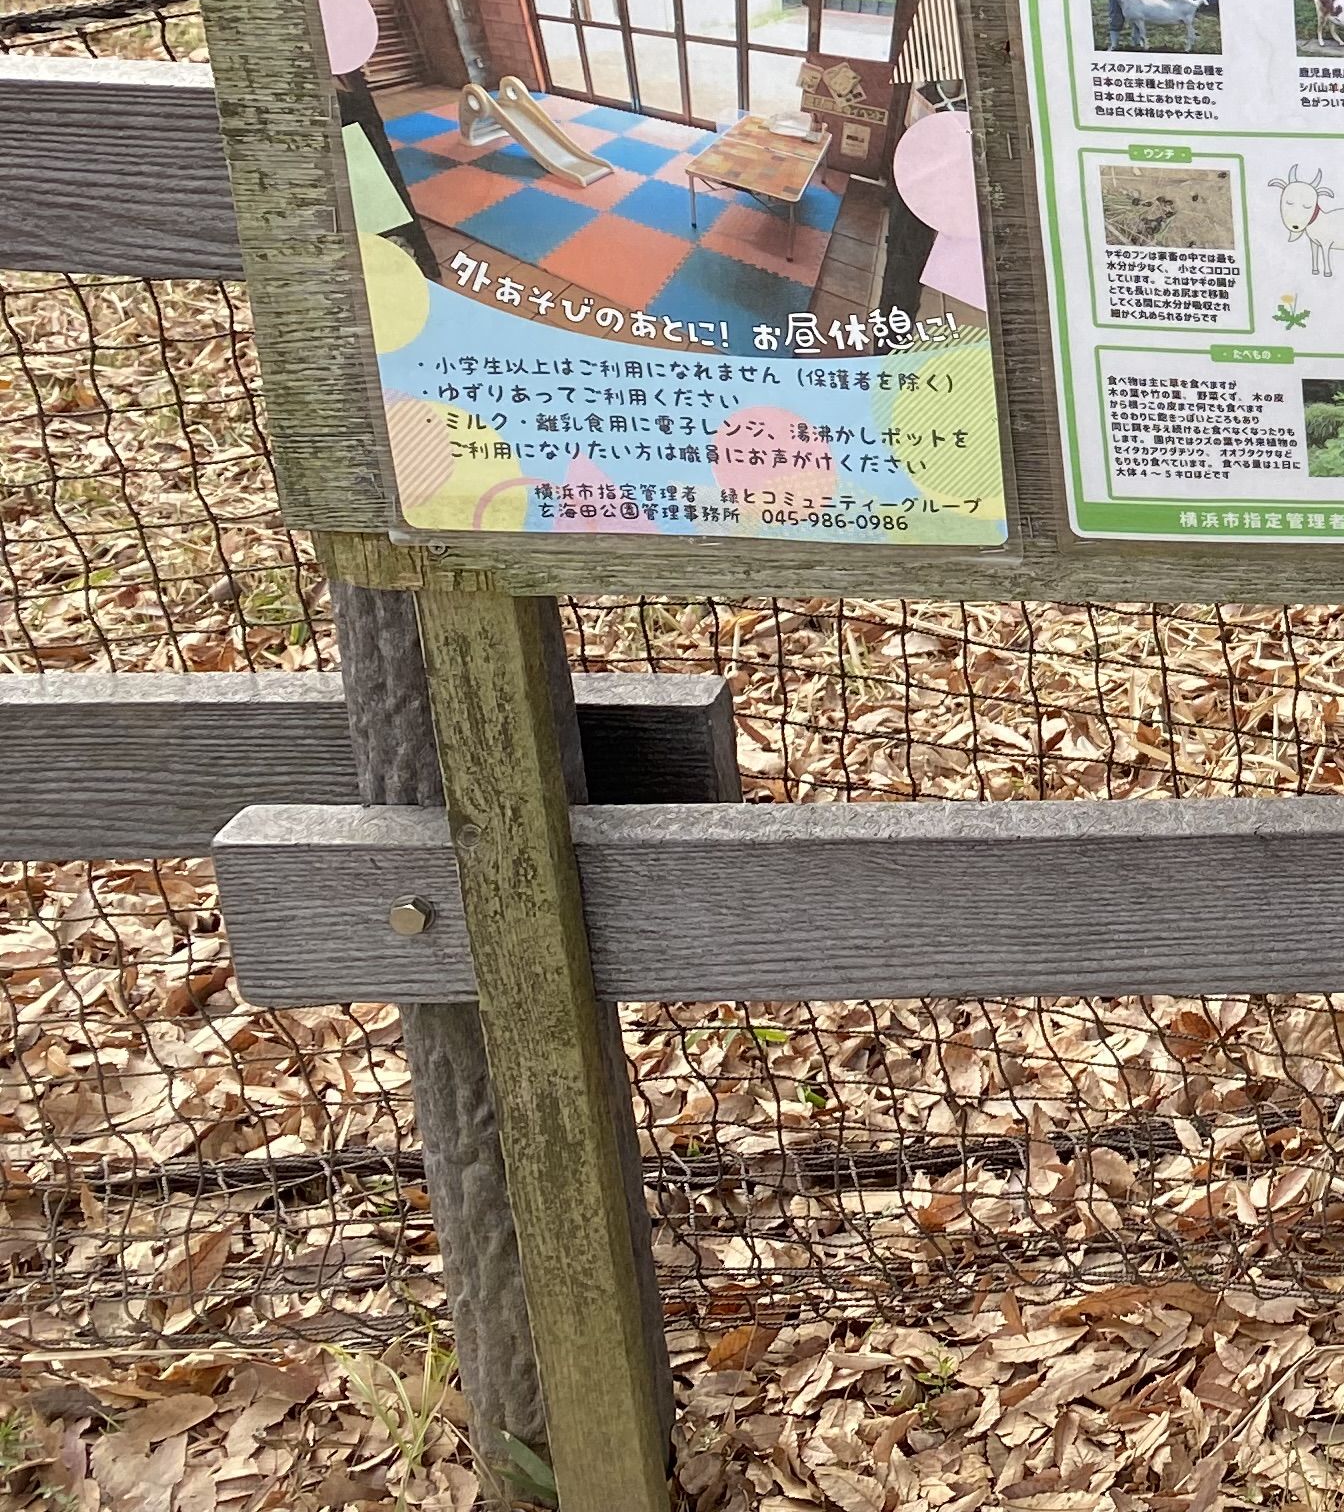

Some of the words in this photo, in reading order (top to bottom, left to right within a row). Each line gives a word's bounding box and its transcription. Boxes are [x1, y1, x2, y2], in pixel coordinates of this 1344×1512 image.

[449, 250, 730, 348] 外あそびのあとに！
[752, 305, 961, 354] お昼休憩に！
[449, 441, 928, 474] ご利用になりたい方は職員にお声がけください
[534, 483, 697, 503] 横浜市指定管理者
[719, 489, 981, 514] 緑とコミュニティーグループ
[537, 501, 741, 524] 玄海田公園管理事務所
[761, 508, 909, 531] 045-986-0986
